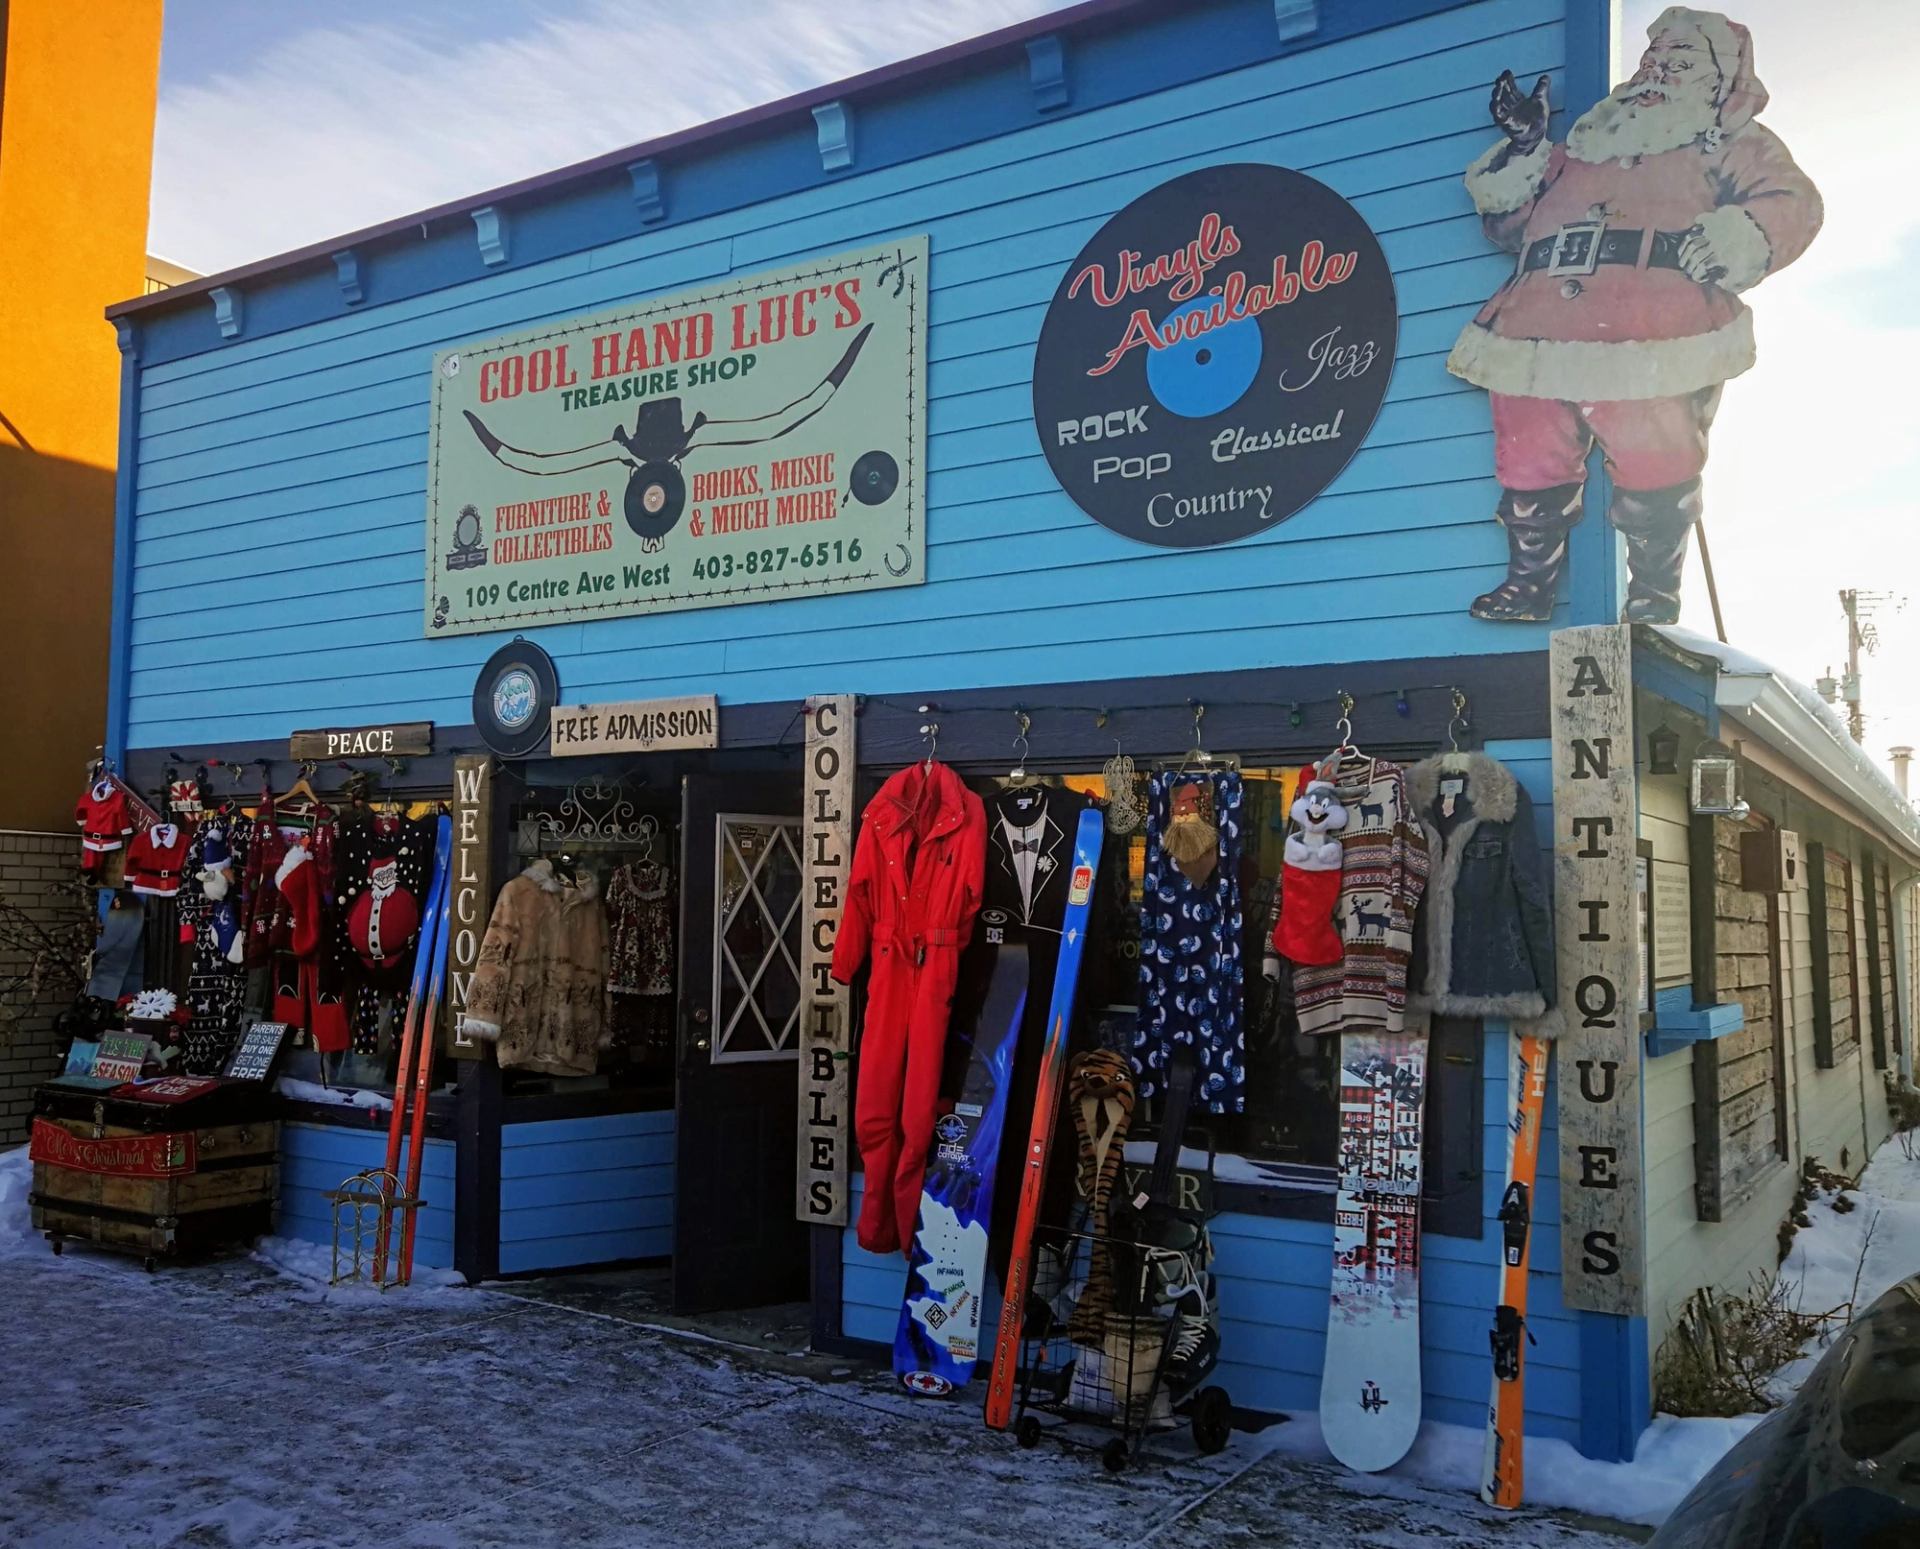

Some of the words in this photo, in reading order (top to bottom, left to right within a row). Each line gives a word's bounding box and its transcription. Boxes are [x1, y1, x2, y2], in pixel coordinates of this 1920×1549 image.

[1067, 212, 1241, 307] Vinyls
[1086, 240, 1358, 376] Available
[479, 343, 578, 403] COOL
[591, 312, 715, 380] HAND
[731, 278, 863, 352] LUC'S
[1279, 326, 1381, 392] Jazz
[561, 369, 679, 412] TREASURE
[687, 352, 757, 387] SHOP
[1057, 405, 1149, 446] ROCK
[1210, 408, 1344, 463] Classical
[692, 463, 763, 502] BOOKS,
[771, 453, 835, 489] MUSIC
[1093, 453, 1172, 484] POP
[495, 495, 593, 534] FURNITURE
[596, 490, 612, 517] &
[689, 509, 705, 538] &
[709, 500, 770, 535] MUCH
[775, 488, 838, 526] MORE
[1147, 484, 1273, 528] Country
[493, 522, 613, 565] COLLECTIBLES
[692, 538, 863, 581] 403-827-6516
[465, 585, 501, 608] 109
[506, 576, 571, 603] Centre
[576, 570, 616, 595] Ave
[623, 563, 671, 589] West
[327, 731, 394, 755] PEACE
[556, 715, 600, 745] FREE
[452, 762, 486, 1048] WELCOME
[810, 704, 842, 1216] COLLECTIBLES
[1567, 656, 1621, 1275] ANTIQUES
[240, 1044, 259, 1054] BUY
[258, 1045, 275, 1055] ONE
[245, 1033, 261, 1044] FOR
[260, 1034, 279, 1045] SALE
[249, 1023, 284, 1035] PARENTS
[98, 1062, 138, 1082] SEASON
[236, 1055, 253, 1066] GET
[252, 1056, 270, 1067] ONE
[1531, 1039, 1550, 1097] HEA
[79, 1144, 145, 1167] Christmas
